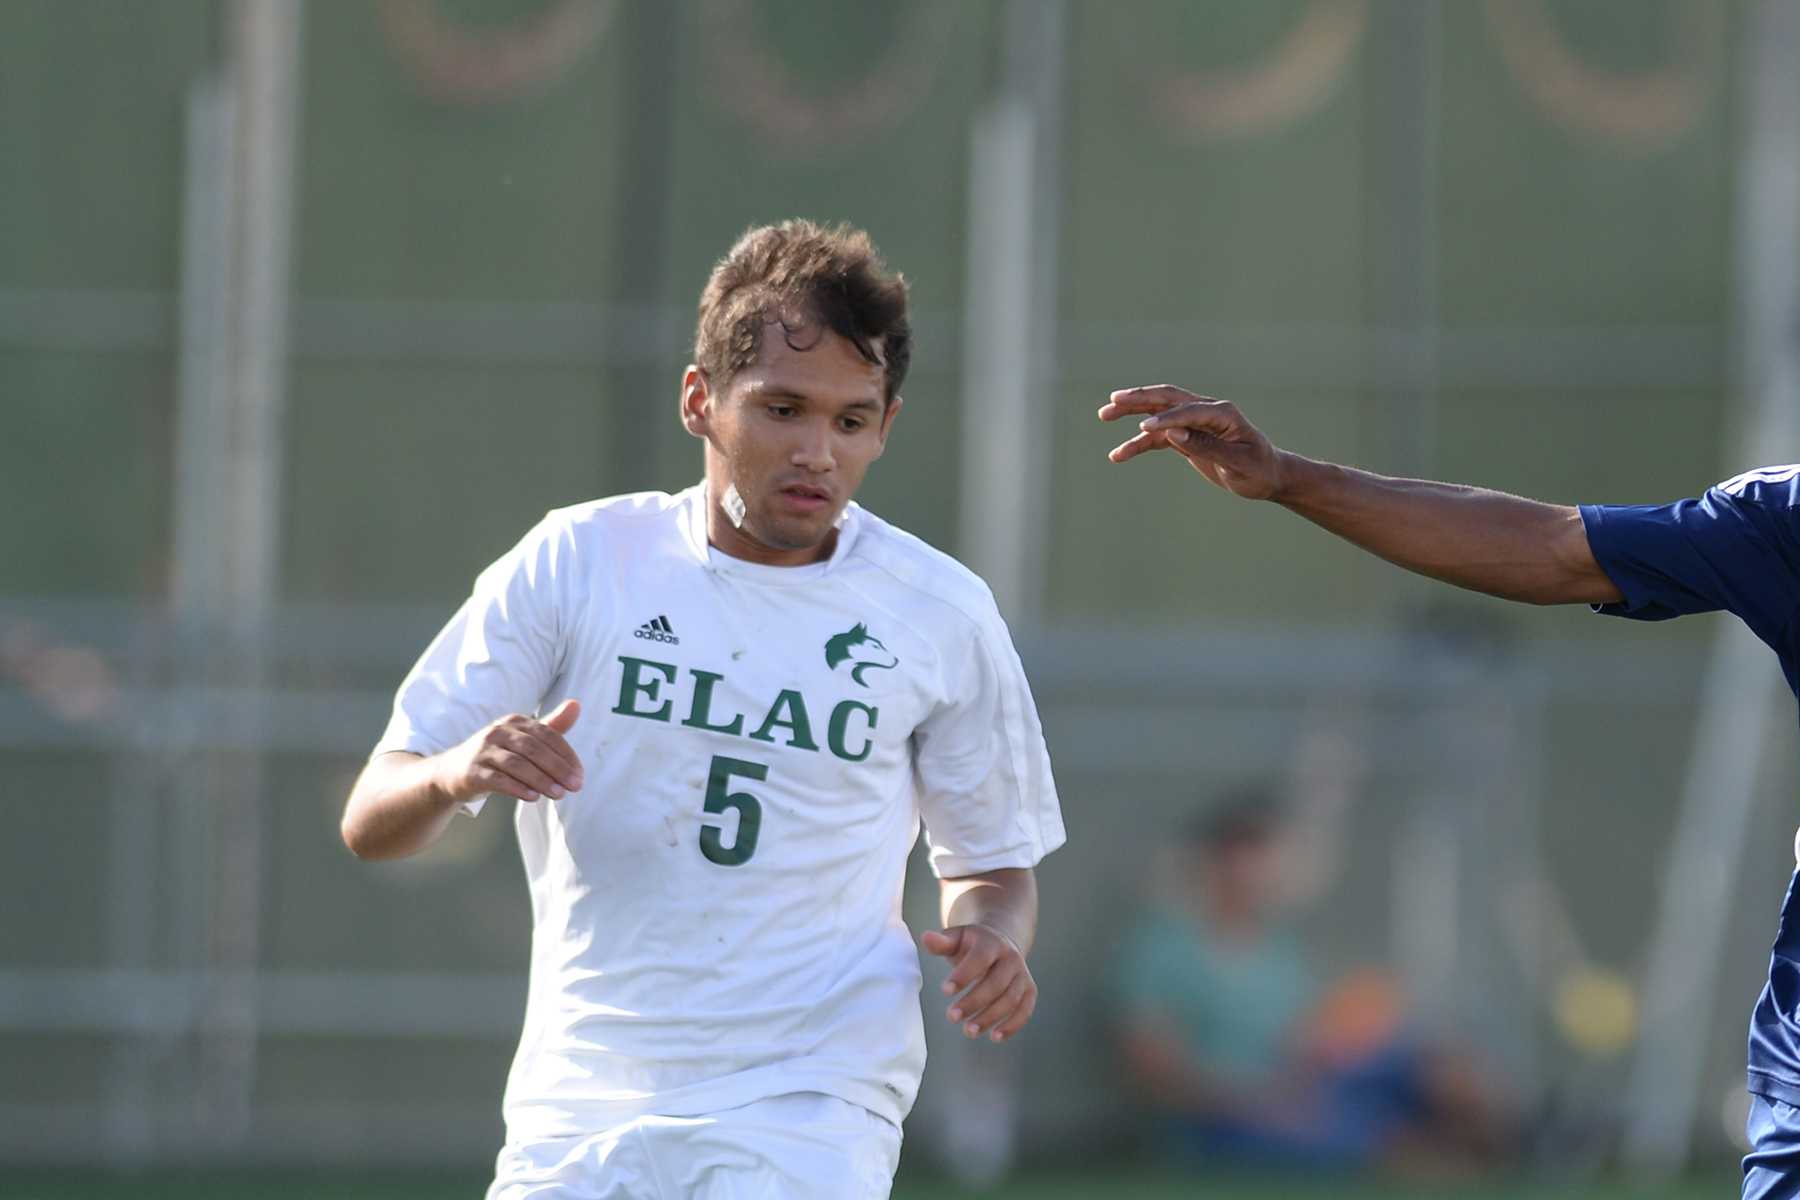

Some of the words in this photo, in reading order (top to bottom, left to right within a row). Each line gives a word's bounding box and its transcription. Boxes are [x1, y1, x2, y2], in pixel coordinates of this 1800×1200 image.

[633, 629, 681, 646] adidas
[611, 656, 880, 762] ELAC
[699, 755, 769, 867] 5
